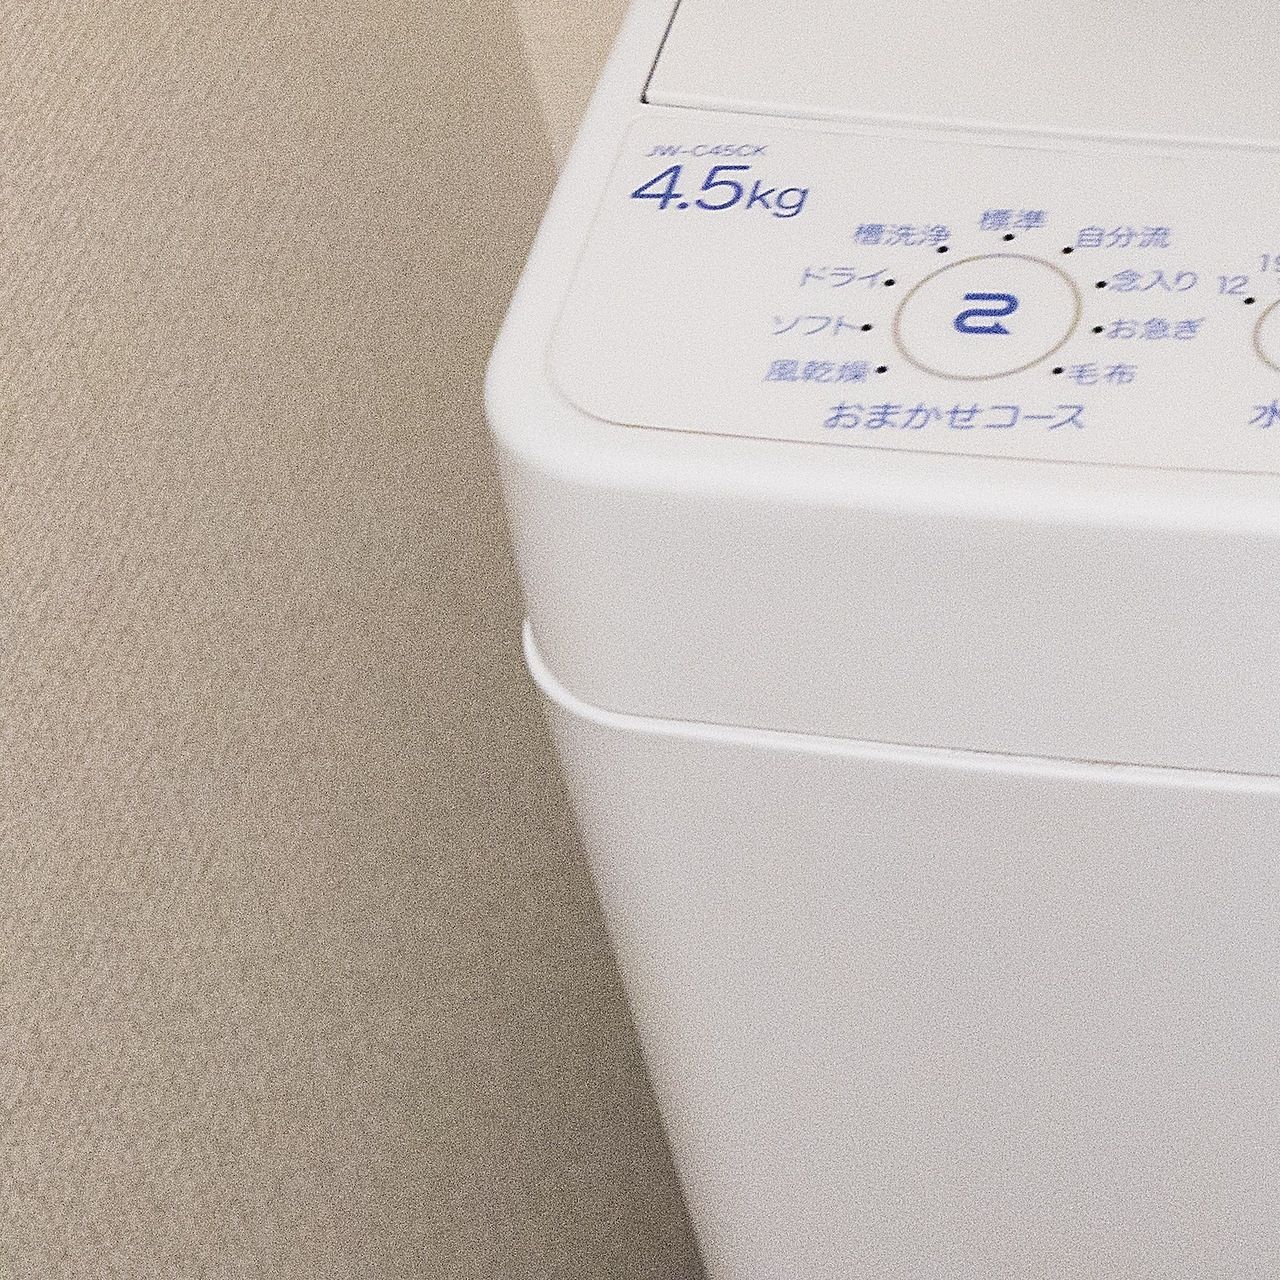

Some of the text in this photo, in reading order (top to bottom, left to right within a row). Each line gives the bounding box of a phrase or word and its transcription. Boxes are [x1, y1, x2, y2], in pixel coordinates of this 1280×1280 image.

[629, 164, 810, 219] 4.5kg
[978, 209, 1047, 231] 標準
[853, 223, 951, 246] 槽洗浄
[1076, 226, 1172, 249] 自分流
[800, 267, 889, 287] ドライ
[1109, 269, 1198, 292] 念入り
[1218, 275, 1249, 295] 12
[773, 316, 858, 336] ソフト
[1108, 317, 1205, 340] お急ぎ
[1068, 363, 1137, 385] 毛布
[823, 401, 1085, 430] おまかせコース
